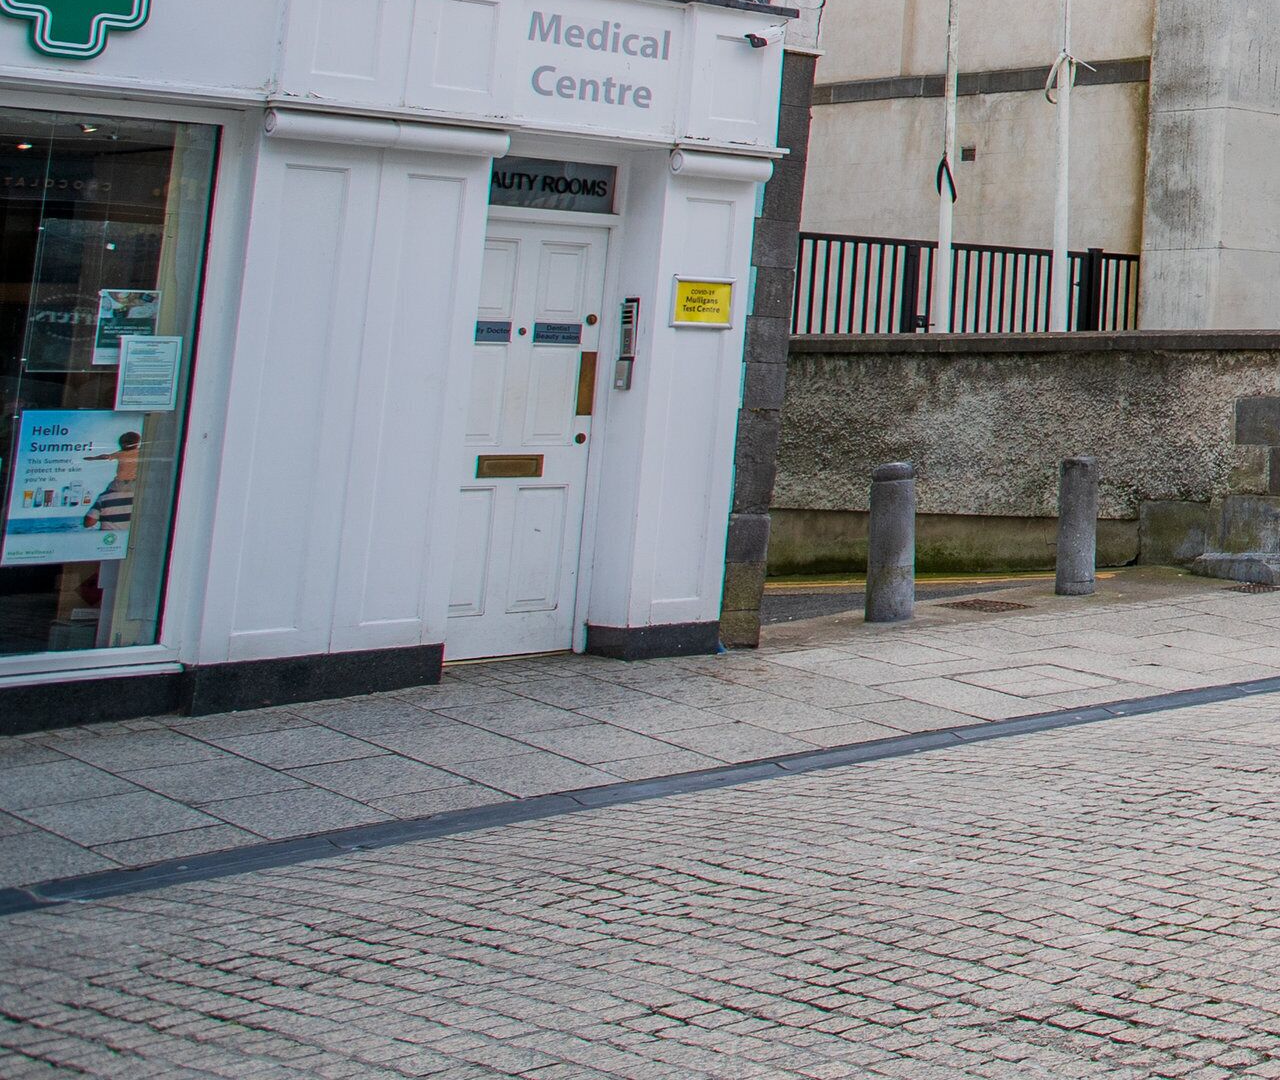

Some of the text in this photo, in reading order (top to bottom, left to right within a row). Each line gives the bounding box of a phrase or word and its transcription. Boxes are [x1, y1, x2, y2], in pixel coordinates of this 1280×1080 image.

[528, 10, 671, 61] Medical
[531, 65, 652, 109] Centre
[541, 176, 607, 197] ROOMS
[690, 288, 715, 296] COVID-19
[686, 296, 719, 306] Mulligans
[683, 305, 721, 314] Test Centre
[546, 324, 571, 332] Dentist
[536, 332, 559, 341] Beauty
[32, 425, 69, 436] Hello
[30, 441, 93, 452] Summer!
